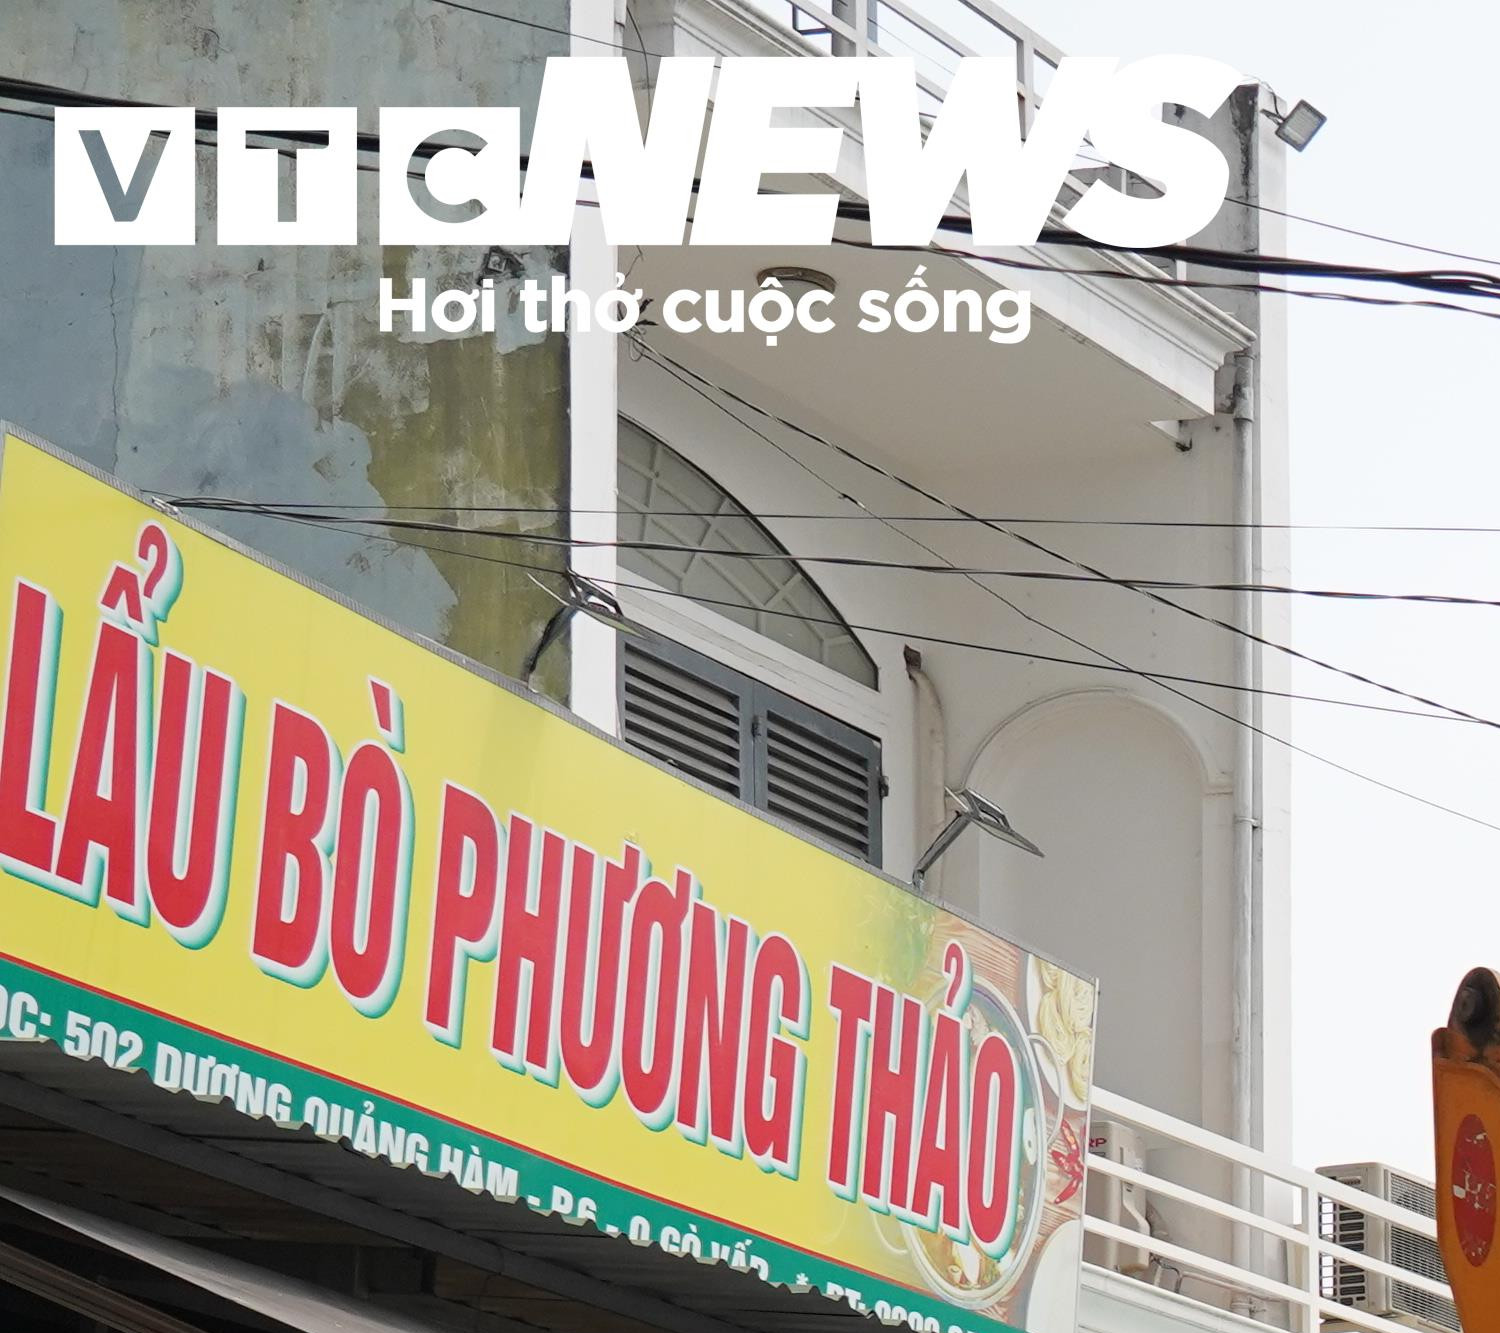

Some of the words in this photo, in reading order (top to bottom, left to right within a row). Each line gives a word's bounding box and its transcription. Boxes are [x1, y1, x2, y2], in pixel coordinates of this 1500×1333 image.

[0, 522, 245, 952] LẨU
[251, 676, 412, 1018] BÒ
[424, 782, 811, 1180] PHƯƠNG
[826, 940, 1030, 1258] THẢO
[64, 1008, 143, 1072] 502
[154, 1041, 293, 1123] DƯƠNG
[303, 1098, 430, 1172] QUẢNG
[440, 1145, 519, 1199] HÀM
